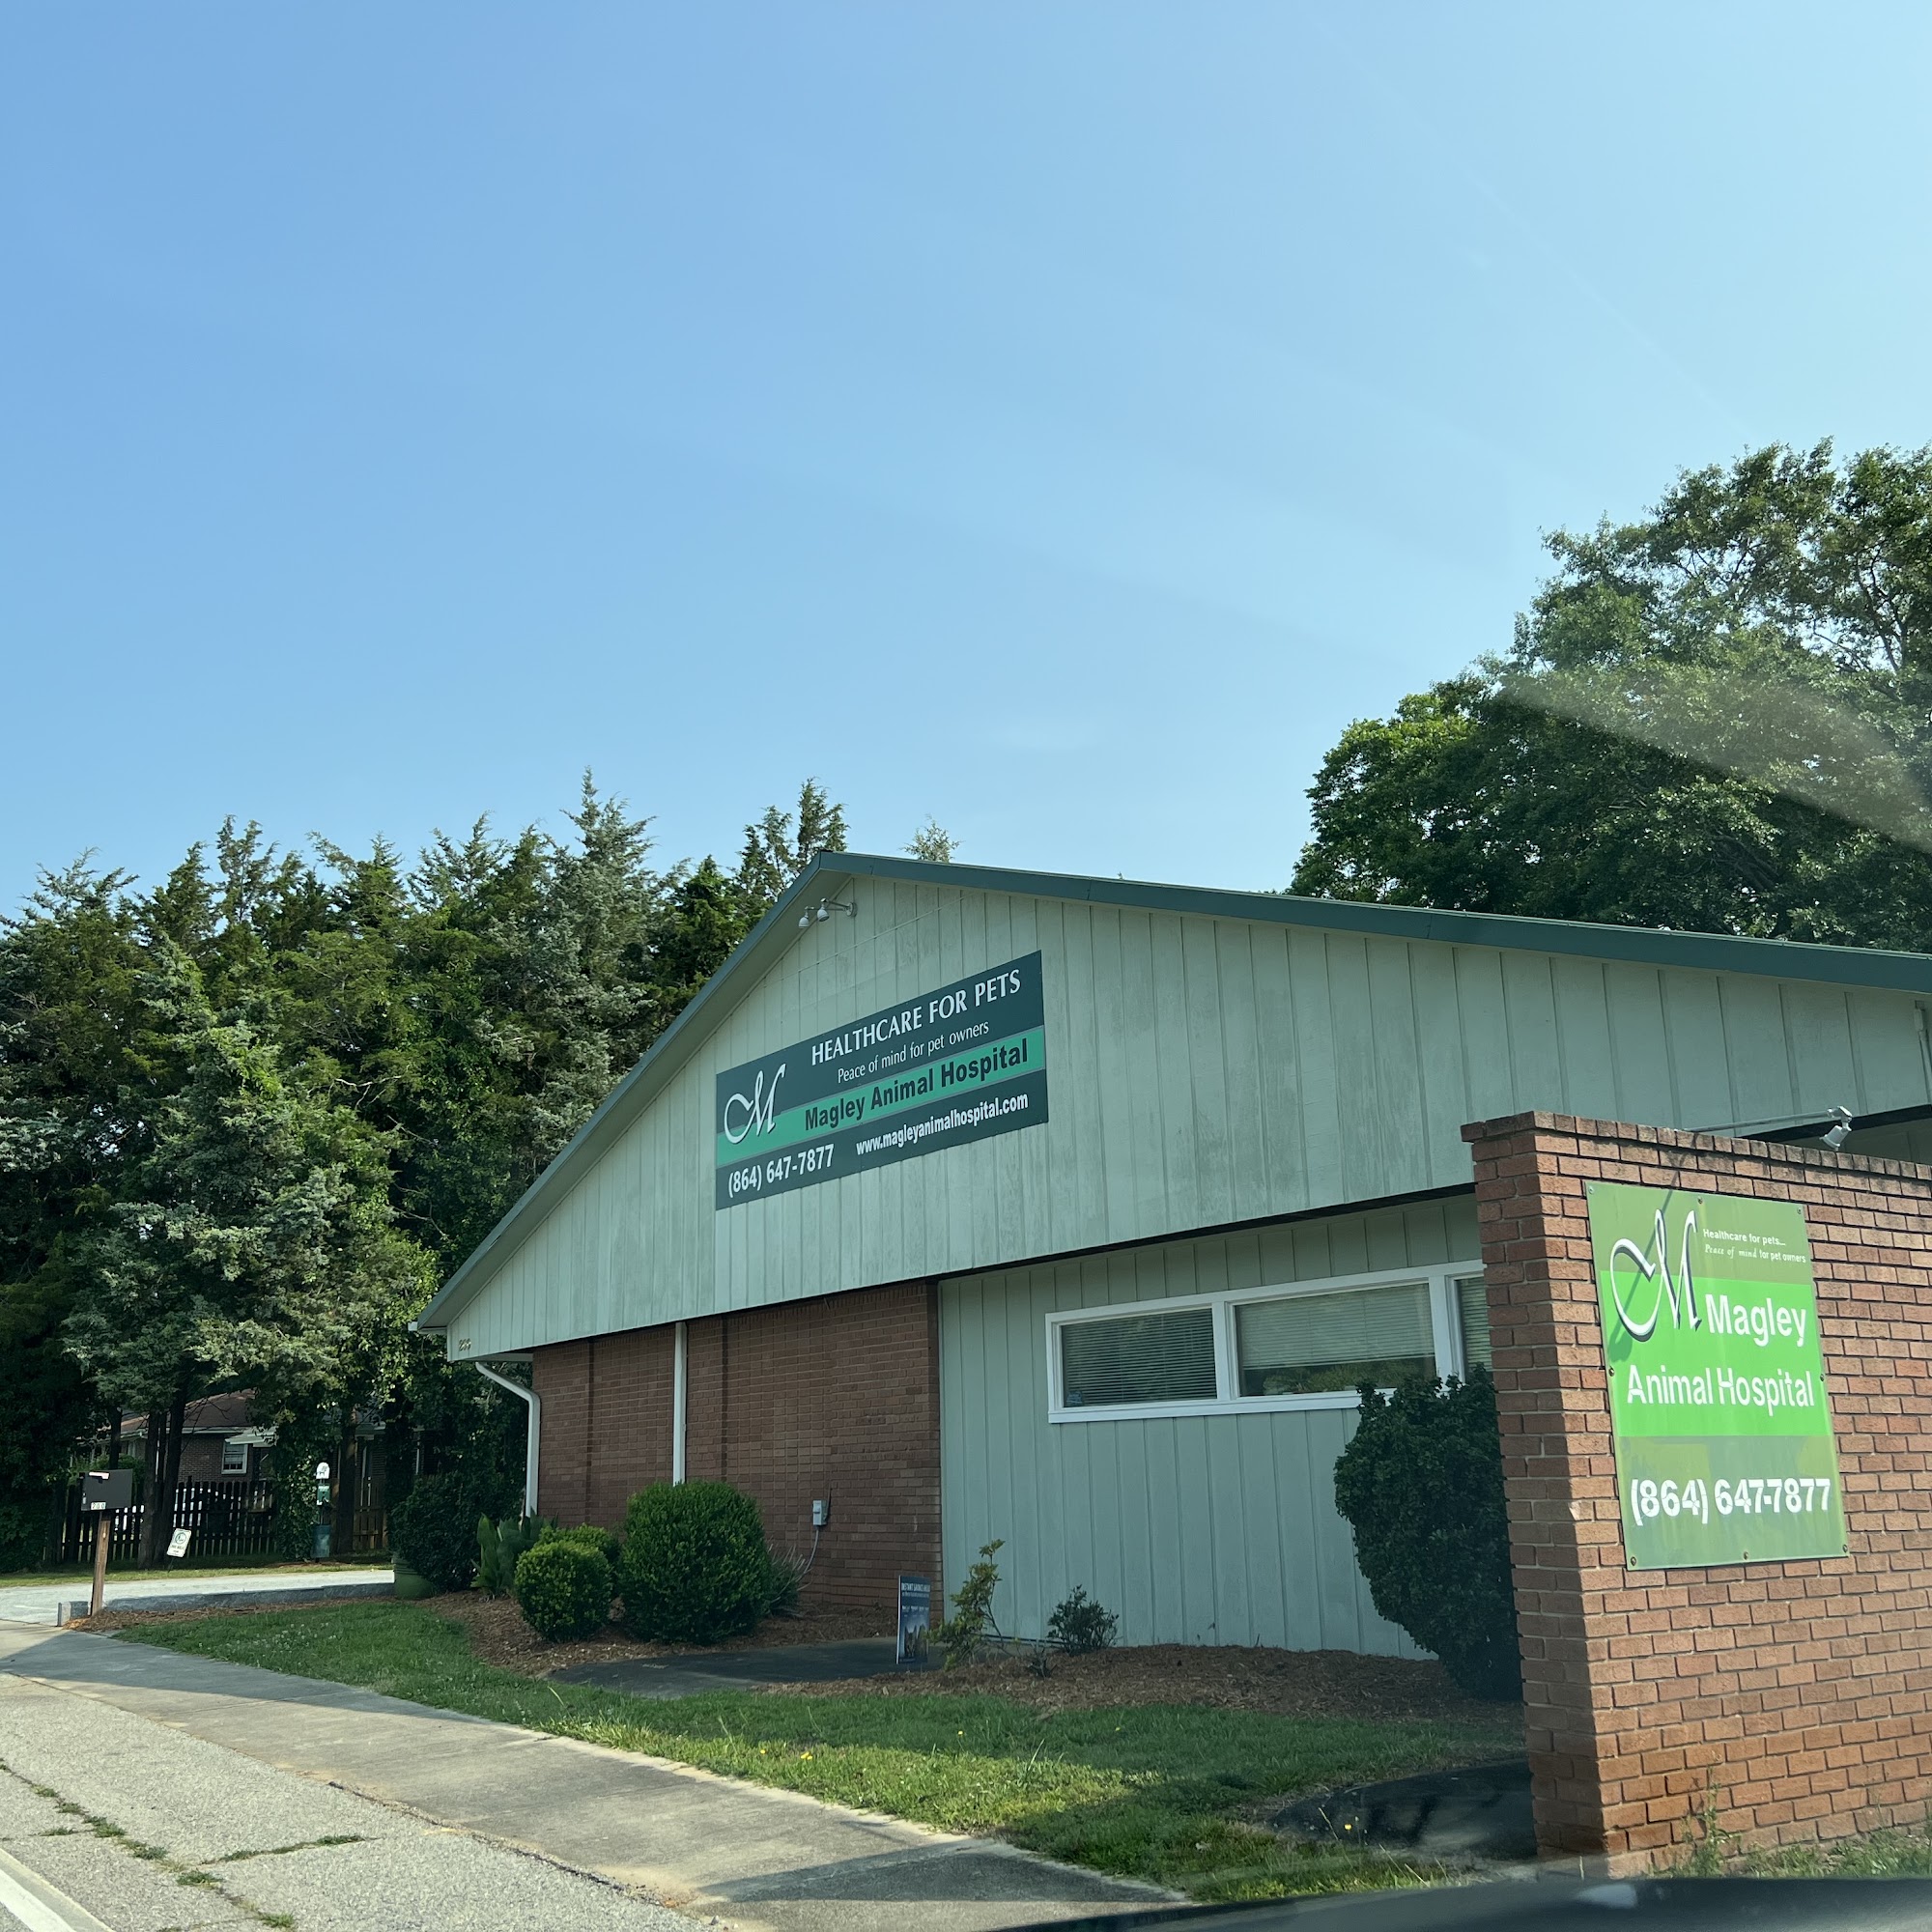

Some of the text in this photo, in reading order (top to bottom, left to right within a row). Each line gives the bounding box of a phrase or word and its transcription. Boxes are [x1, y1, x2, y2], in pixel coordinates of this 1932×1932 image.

[811, 969, 1021, 1065] HEALTHCARE FOR PETS
[838, 1021, 989, 1083] Peace of mind for pet owners
[805, 1038, 1028, 1130] Magley Animal Hospital
[856, 1092, 1029, 1155] www.magleyanimalhospital.com
[727, 1144, 835, 1198] (864) 647-7877
[1703, 1229, 1747, 1242] Healthcare
[1748, 1234, 1760, 1243] for
[1705, 1244, 1805, 1264] Peace of mind for pet owners
[1705, 1293, 1806, 1348] Magley
[1628, 1364, 1815, 1417] Animal Hospital
[1630, 1478, 1831, 1526] (864) 647-7877
